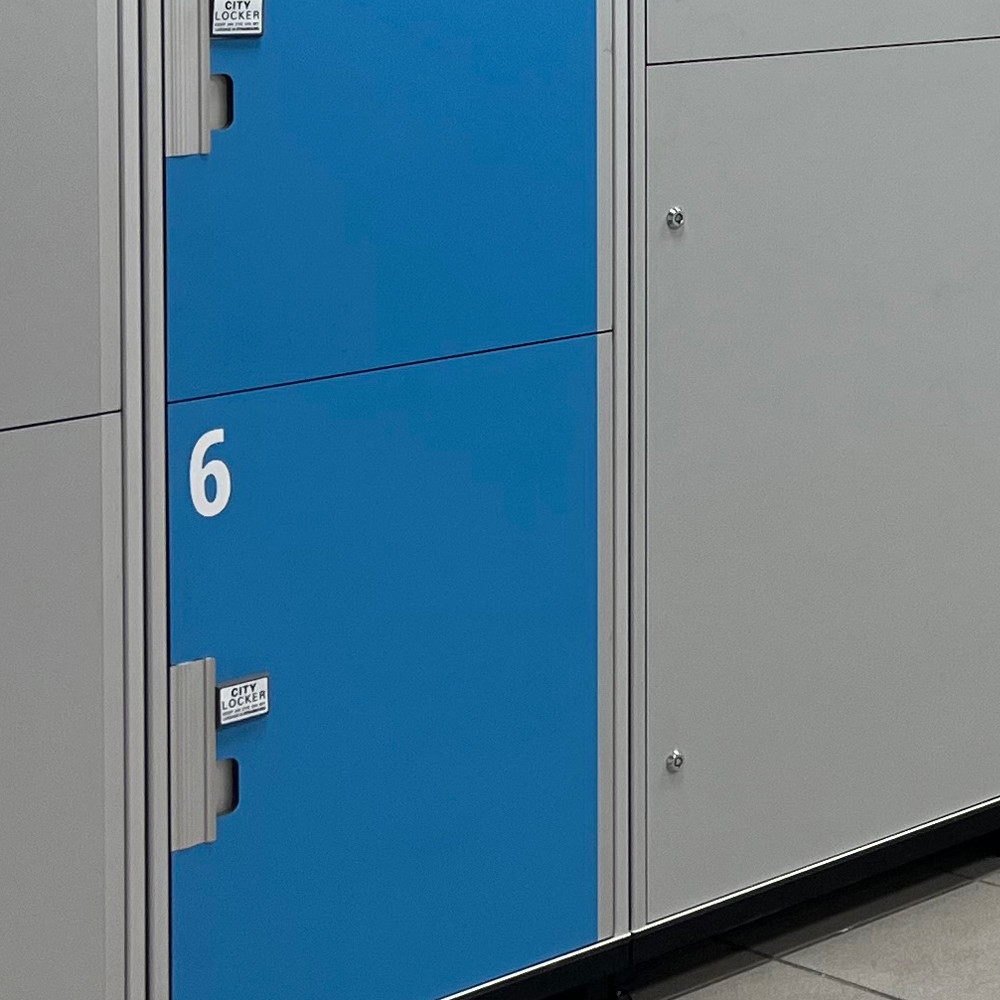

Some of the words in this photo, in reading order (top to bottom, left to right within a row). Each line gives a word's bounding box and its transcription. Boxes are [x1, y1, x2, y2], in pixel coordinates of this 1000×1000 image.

[224, 0, 251, 10] CITY
[214, 10, 260, 21] LOCKER
[189, 428, 231, 517] 6
[231, 682, 256, 698] CITY
[221, 690, 266, 710] LOCKER
